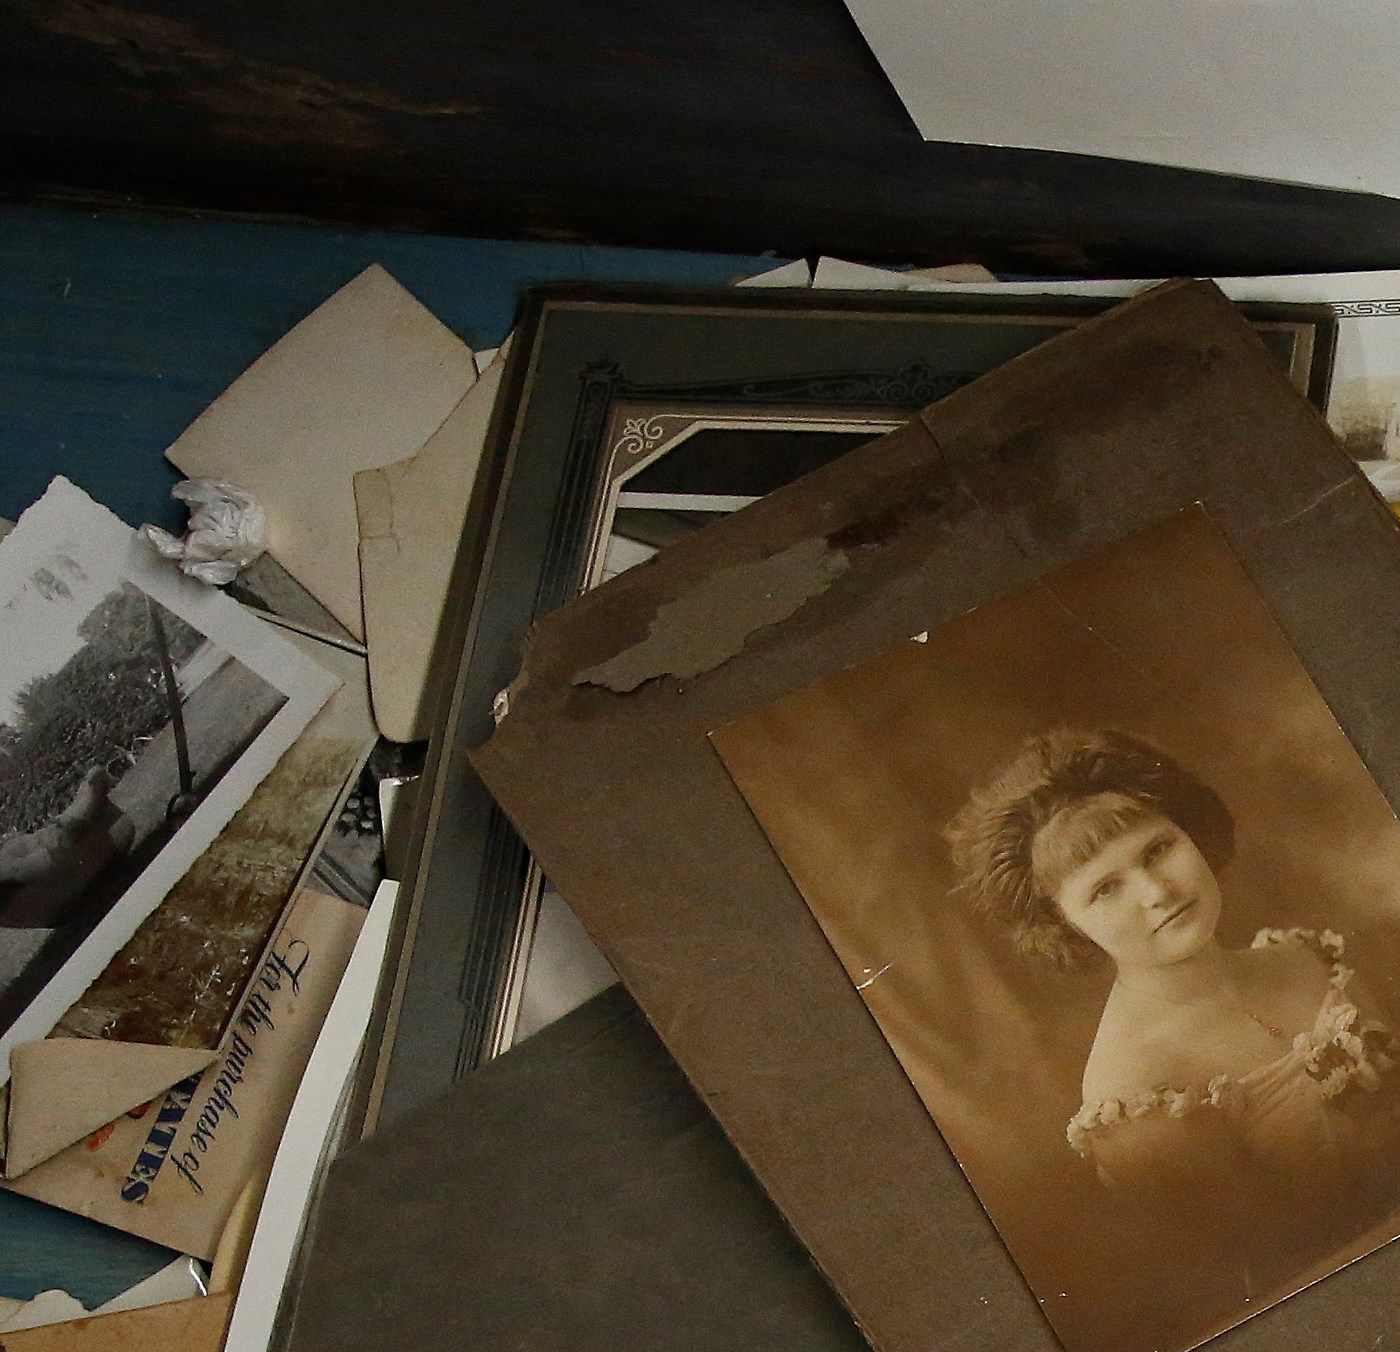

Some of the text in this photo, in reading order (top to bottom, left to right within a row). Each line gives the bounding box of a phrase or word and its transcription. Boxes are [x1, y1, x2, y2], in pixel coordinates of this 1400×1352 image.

[169, 937, 310, 1194] For the purchase of
